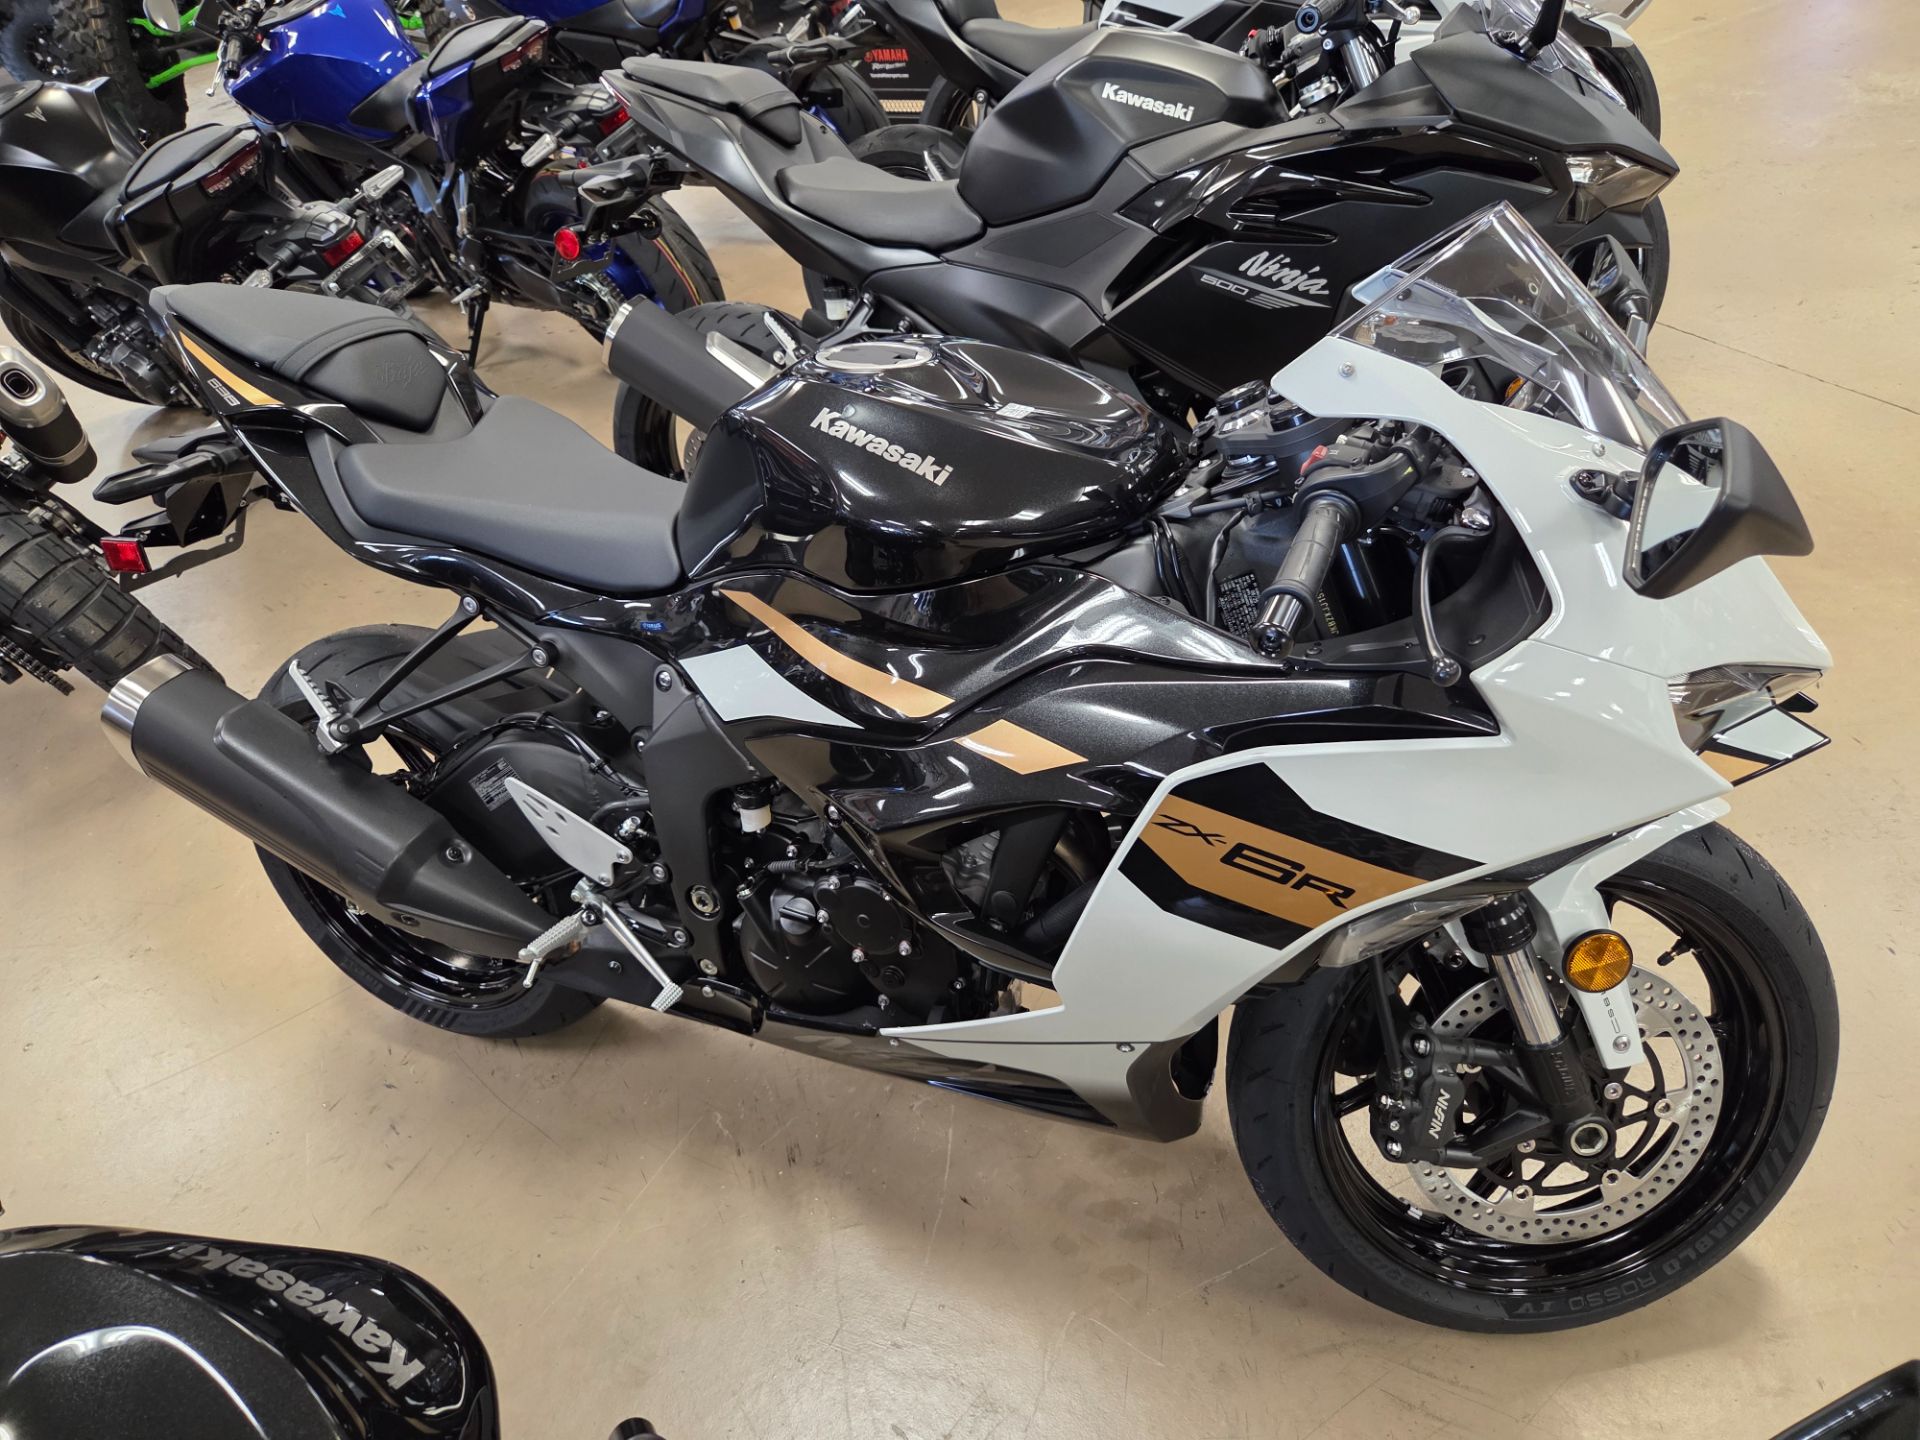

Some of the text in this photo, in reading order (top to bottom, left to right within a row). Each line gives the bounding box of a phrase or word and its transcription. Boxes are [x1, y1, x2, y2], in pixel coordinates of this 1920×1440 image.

[872, 48, 909, 62] YAMAHA
[1102, 82, 1195, 121] Kawasaki
[1201, 274, 1249, 295] 500
[1238, 251, 1330, 294] Ninja
[207, 377, 241, 406] 636
[809, 406, 954, 487] Kawasaki
[1151, 814, 1356, 910] ZX-6R
[1428, 1088, 1451, 1139] NISSIN
[1661, 1202, 1750, 1277] DIABLO
[1568, 1271, 1657, 1312] ROSSO
[169, 1241, 425, 1390] Kawasaki
